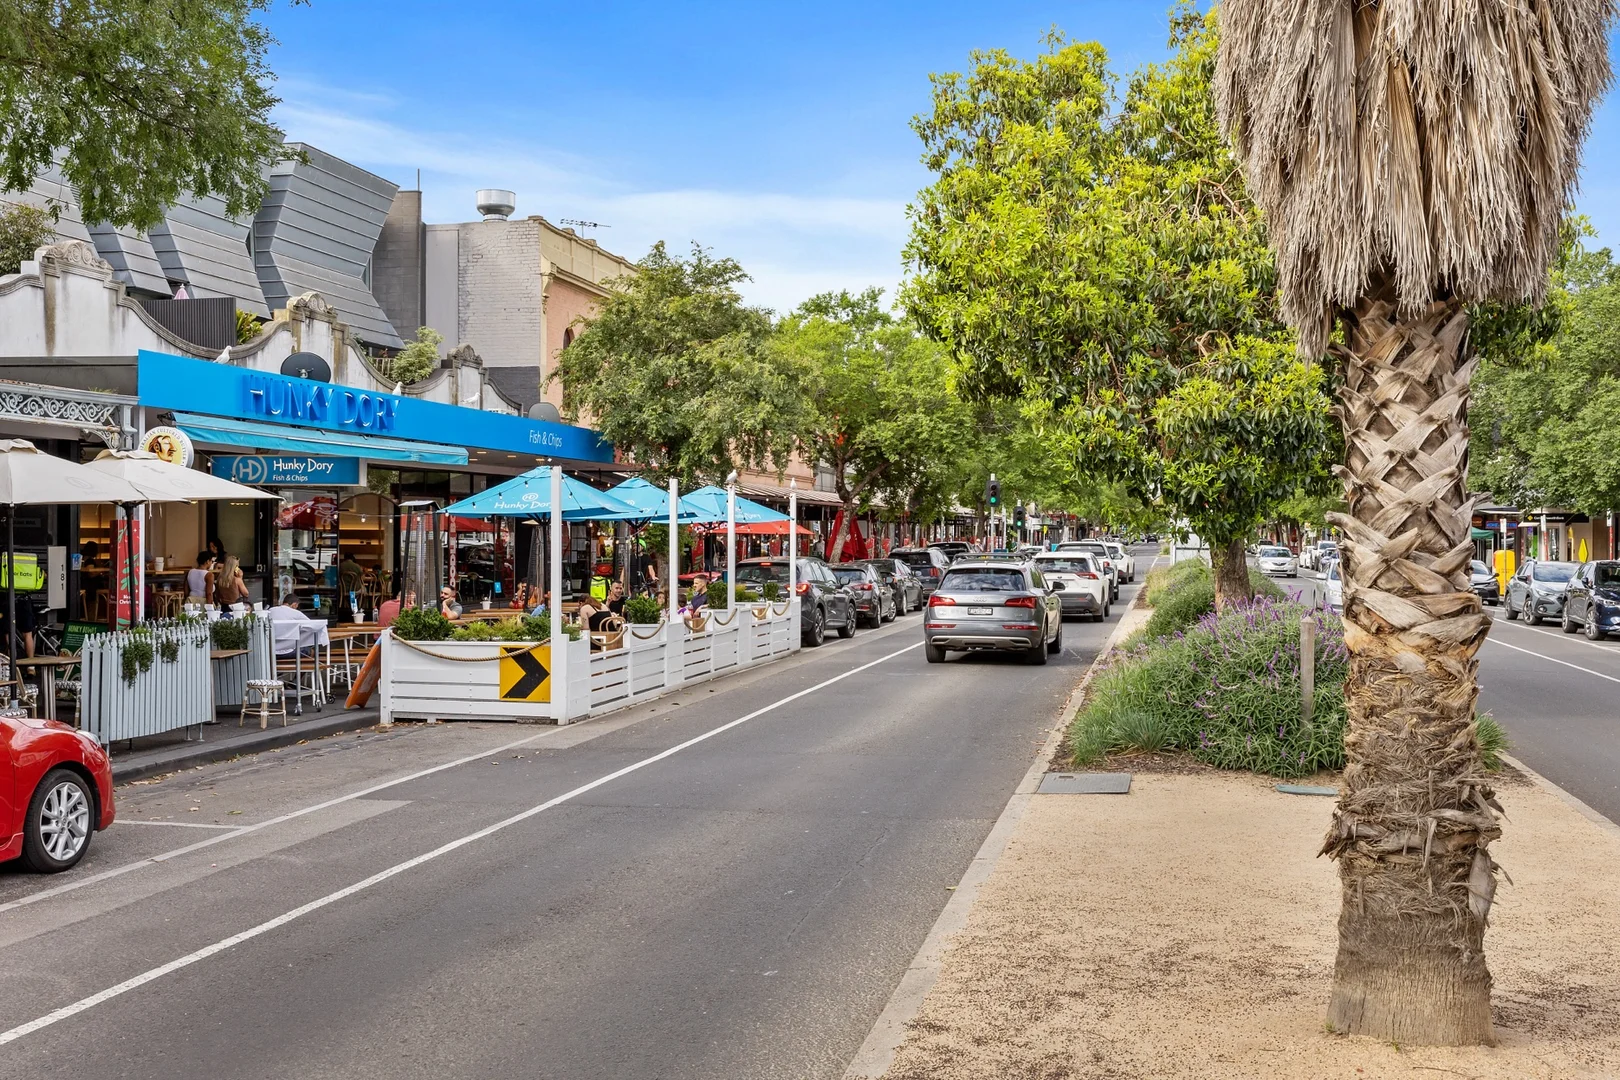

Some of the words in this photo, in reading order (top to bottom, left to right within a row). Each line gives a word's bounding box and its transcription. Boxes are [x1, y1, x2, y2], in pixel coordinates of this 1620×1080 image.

[242, 374, 335, 423] HUNKY
[338, 390, 401, 431] DORY
[528, 429, 541, 444] Fish
[542, 431, 548, 445] &
[547, 432, 563, 449] Chips
[273, 458, 306, 474] Hunky
[307, 458, 334, 474] Dory
[291, 474, 308, 482] Chips
[494, 501, 529, 510] Hunky
[530, 501, 552, 509] Dor
